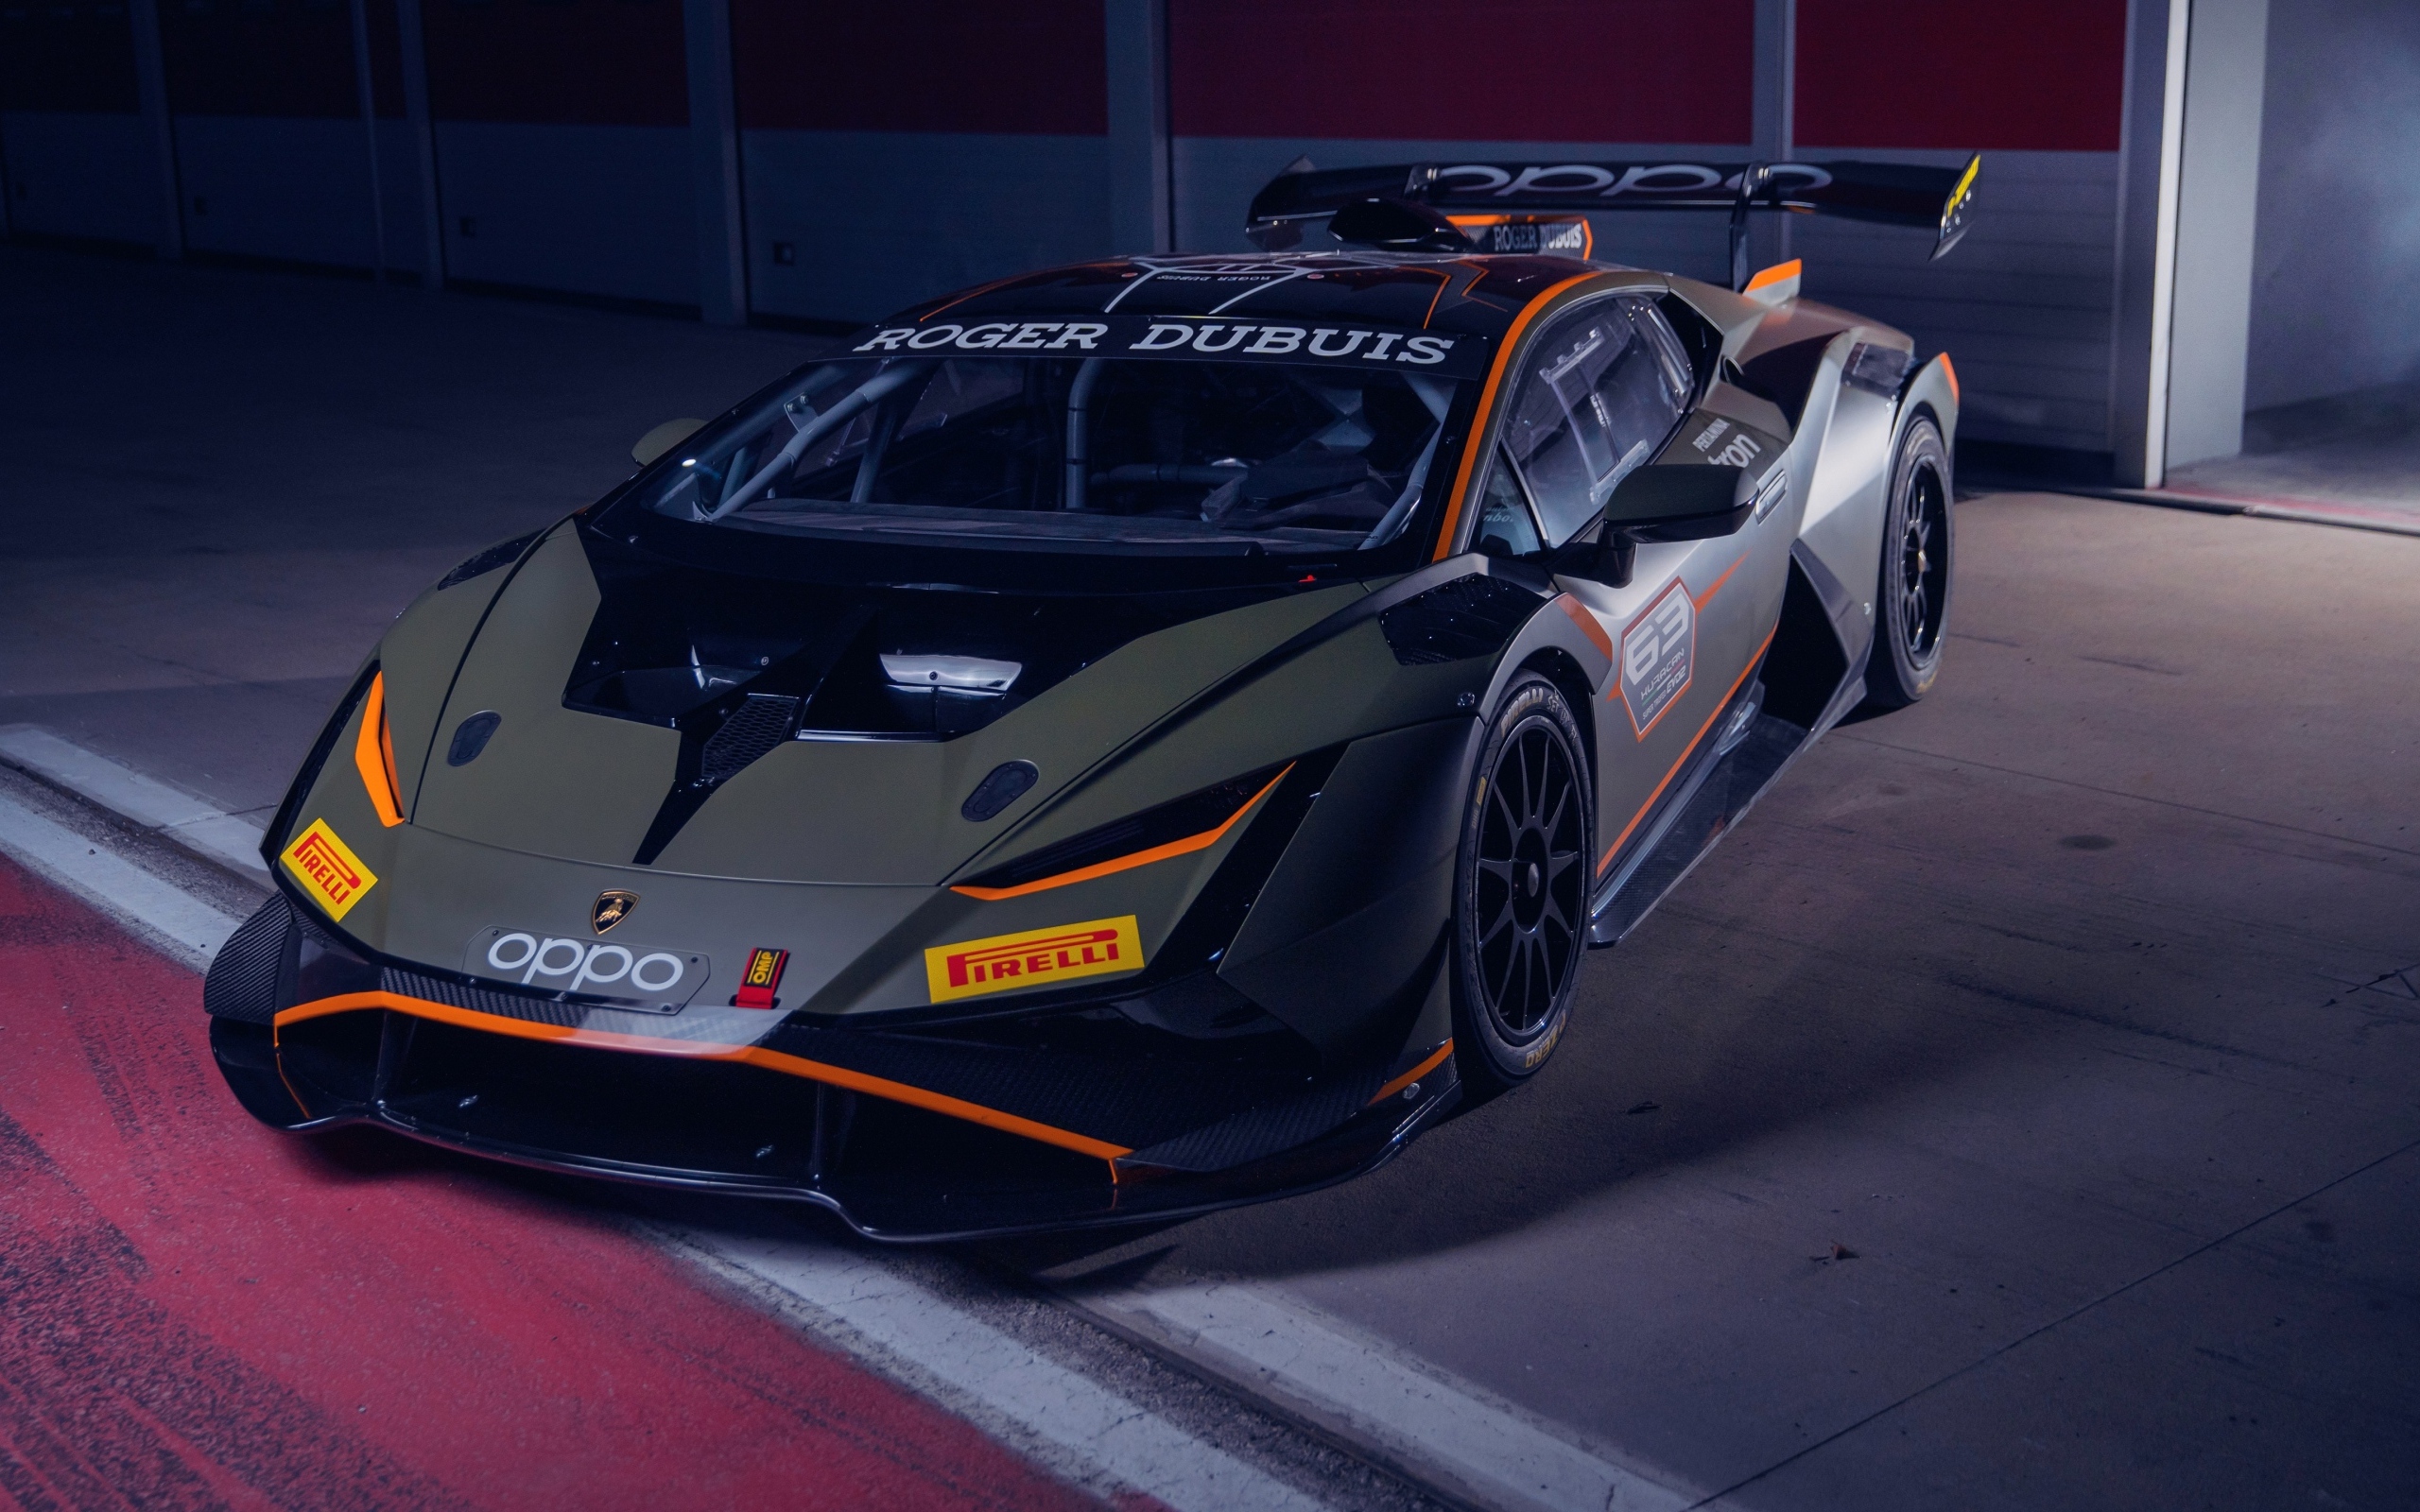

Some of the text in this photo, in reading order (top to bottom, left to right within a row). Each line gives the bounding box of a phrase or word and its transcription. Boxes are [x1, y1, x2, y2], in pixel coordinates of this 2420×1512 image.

[1436, 164, 1833, 197] oppo
[1494, 225, 1537, 251] ROGER
[854, 322, 1456, 366] ROGER DUBUIS
[1625, 593, 1689, 686] 63
[1501, 687, 1544, 739] PIRELLI
[294, 833, 363, 905] PIRELLI
[488, 933, 684, 992] oppo
[752, 951, 773, 985] OMP
[947, 929, 1120, 988] PIRELLI
[1524, 1024, 1560, 1070] ZERO
